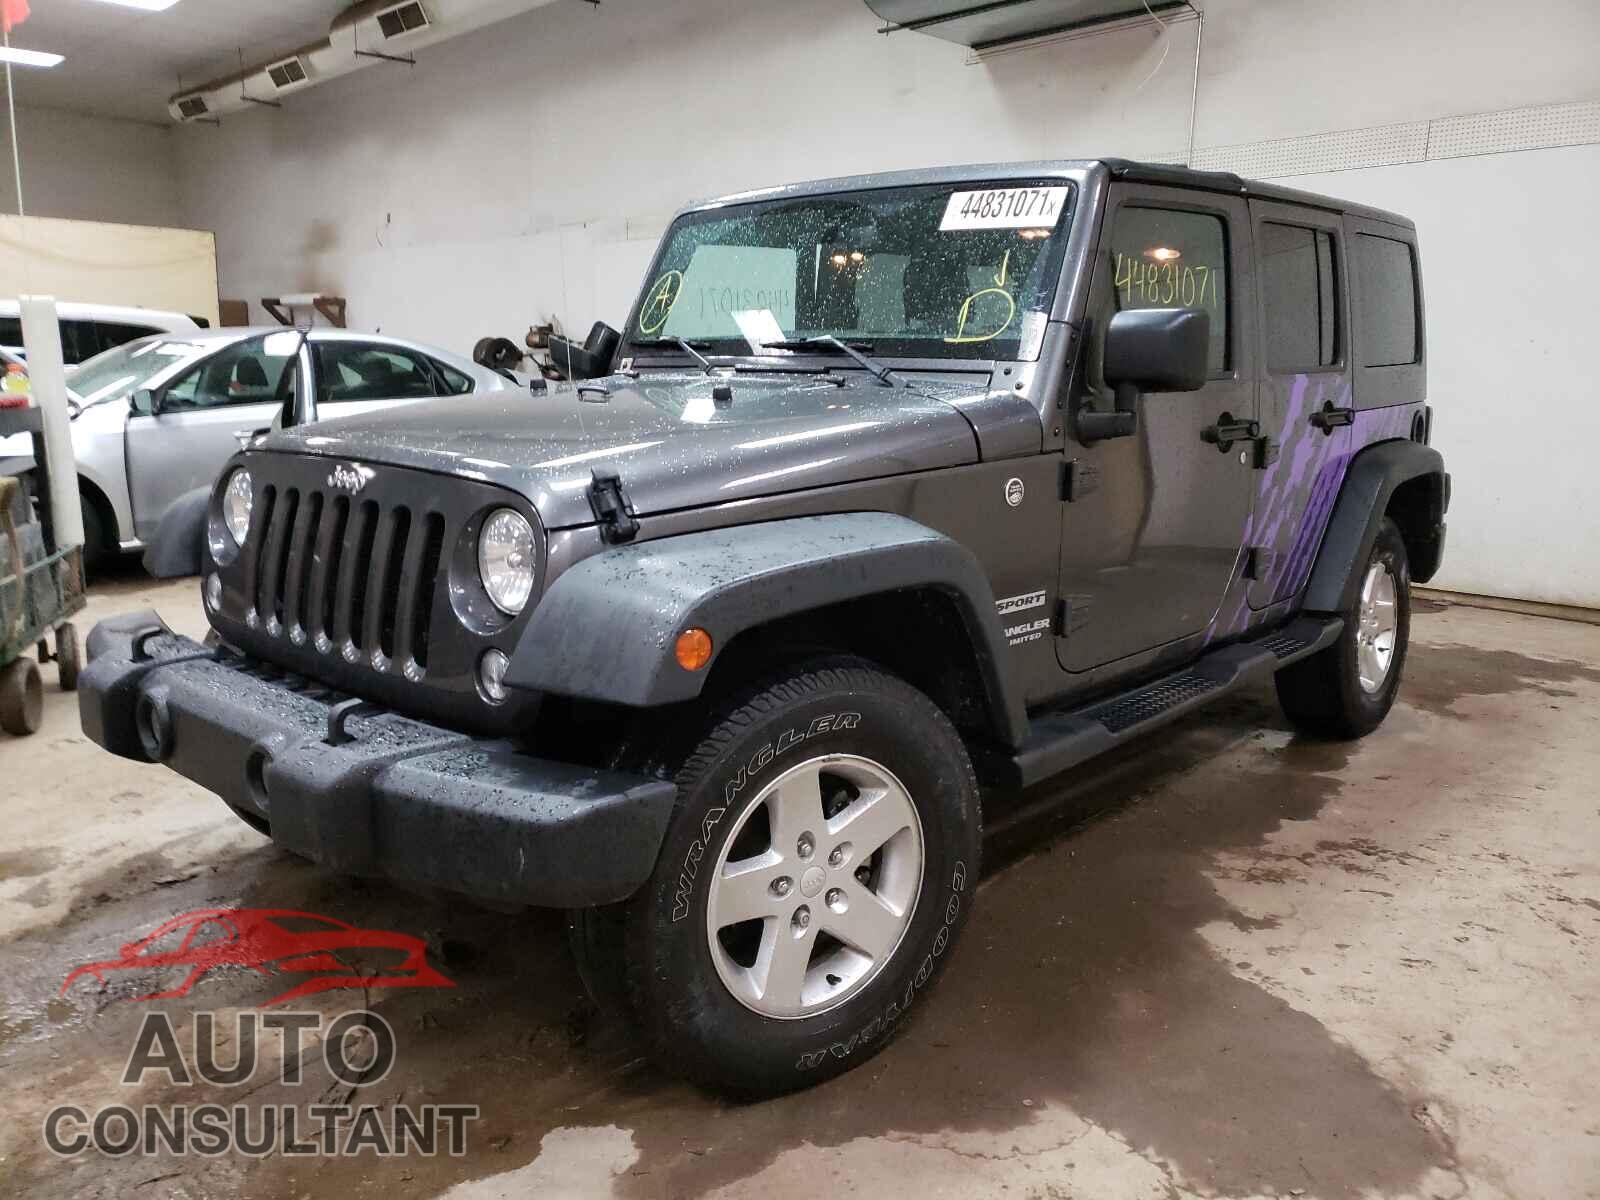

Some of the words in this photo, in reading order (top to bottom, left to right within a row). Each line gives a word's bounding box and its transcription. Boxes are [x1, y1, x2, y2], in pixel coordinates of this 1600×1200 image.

[1114, 252, 1218, 308] 44831071
[996, 593, 1047, 612] SPORT
[672, 712, 862, 922] WRANGLER
